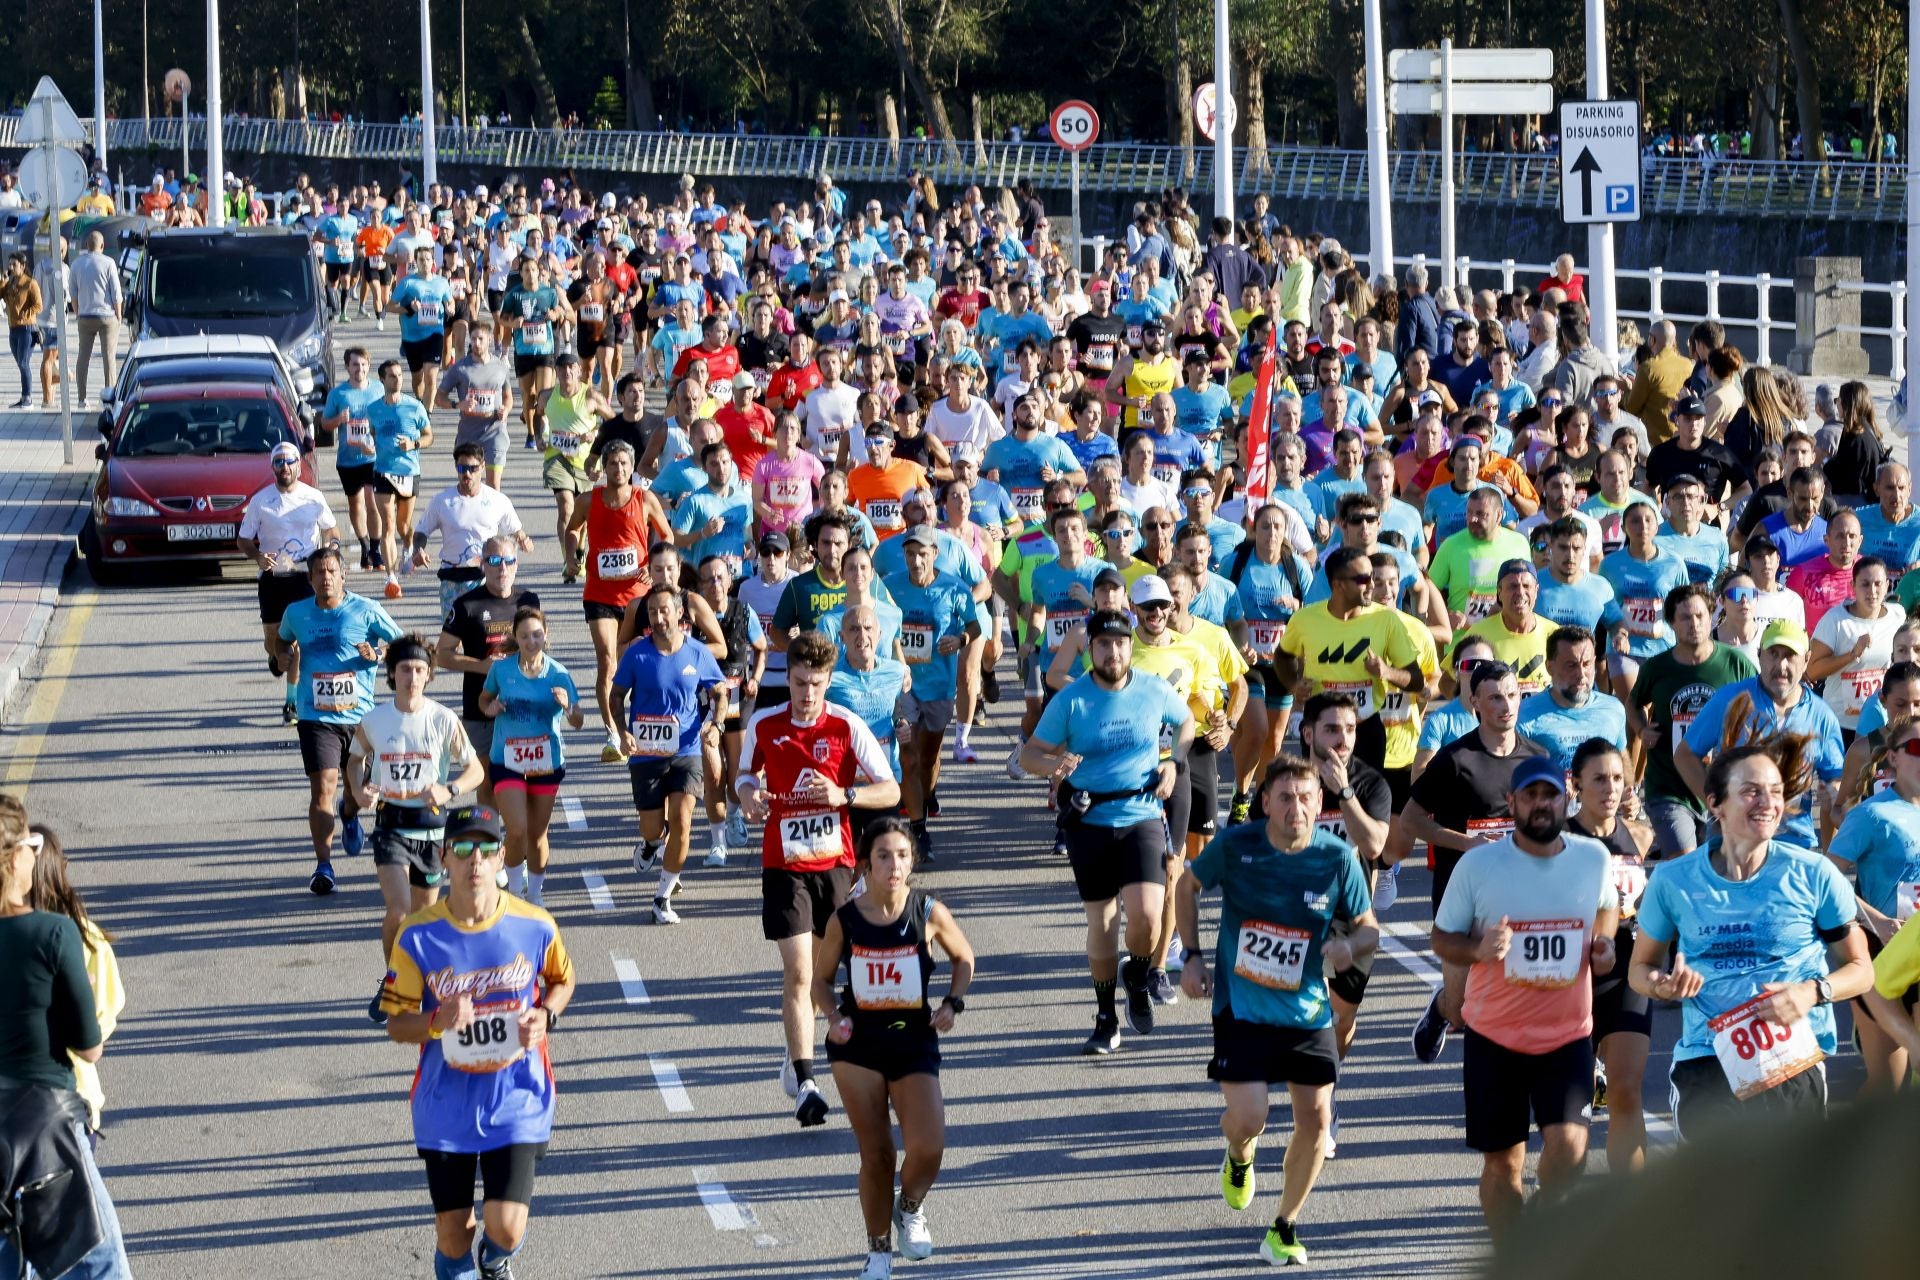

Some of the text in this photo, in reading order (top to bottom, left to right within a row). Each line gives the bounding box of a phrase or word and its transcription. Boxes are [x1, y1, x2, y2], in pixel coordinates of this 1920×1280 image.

[1576, 106, 1624, 119] PARKING
[1061, 118, 1088, 133] 50
[1566, 126, 1635, 139] DISUASORIO
[1611, 187, 1629, 211] P
[870, 505, 899, 517] 1864
[184, 526, 213, 538] 3020
[219, 525, 235, 537] CH
[602, 553, 634, 569] 2388
[811, 592, 847, 612] POPE
[900, 633, 925, 648] 319
[317, 681, 353, 696] 2320
[639, 723, 673, 741] 2170
[513, 745, 544, 762] 346
[390, 762, 422, 781] 527
[788, 816, 834, 841] 2140
[1718, 923, 1752, 934] MBA
[1244, 931, 1304, 966] 2245
[1523, 934, 1566, 961] 910
[427, 953, 533, 1000] Venezuela
[866, 962, 903, 986] 114
[457, 1018, 507, 1046] 908
